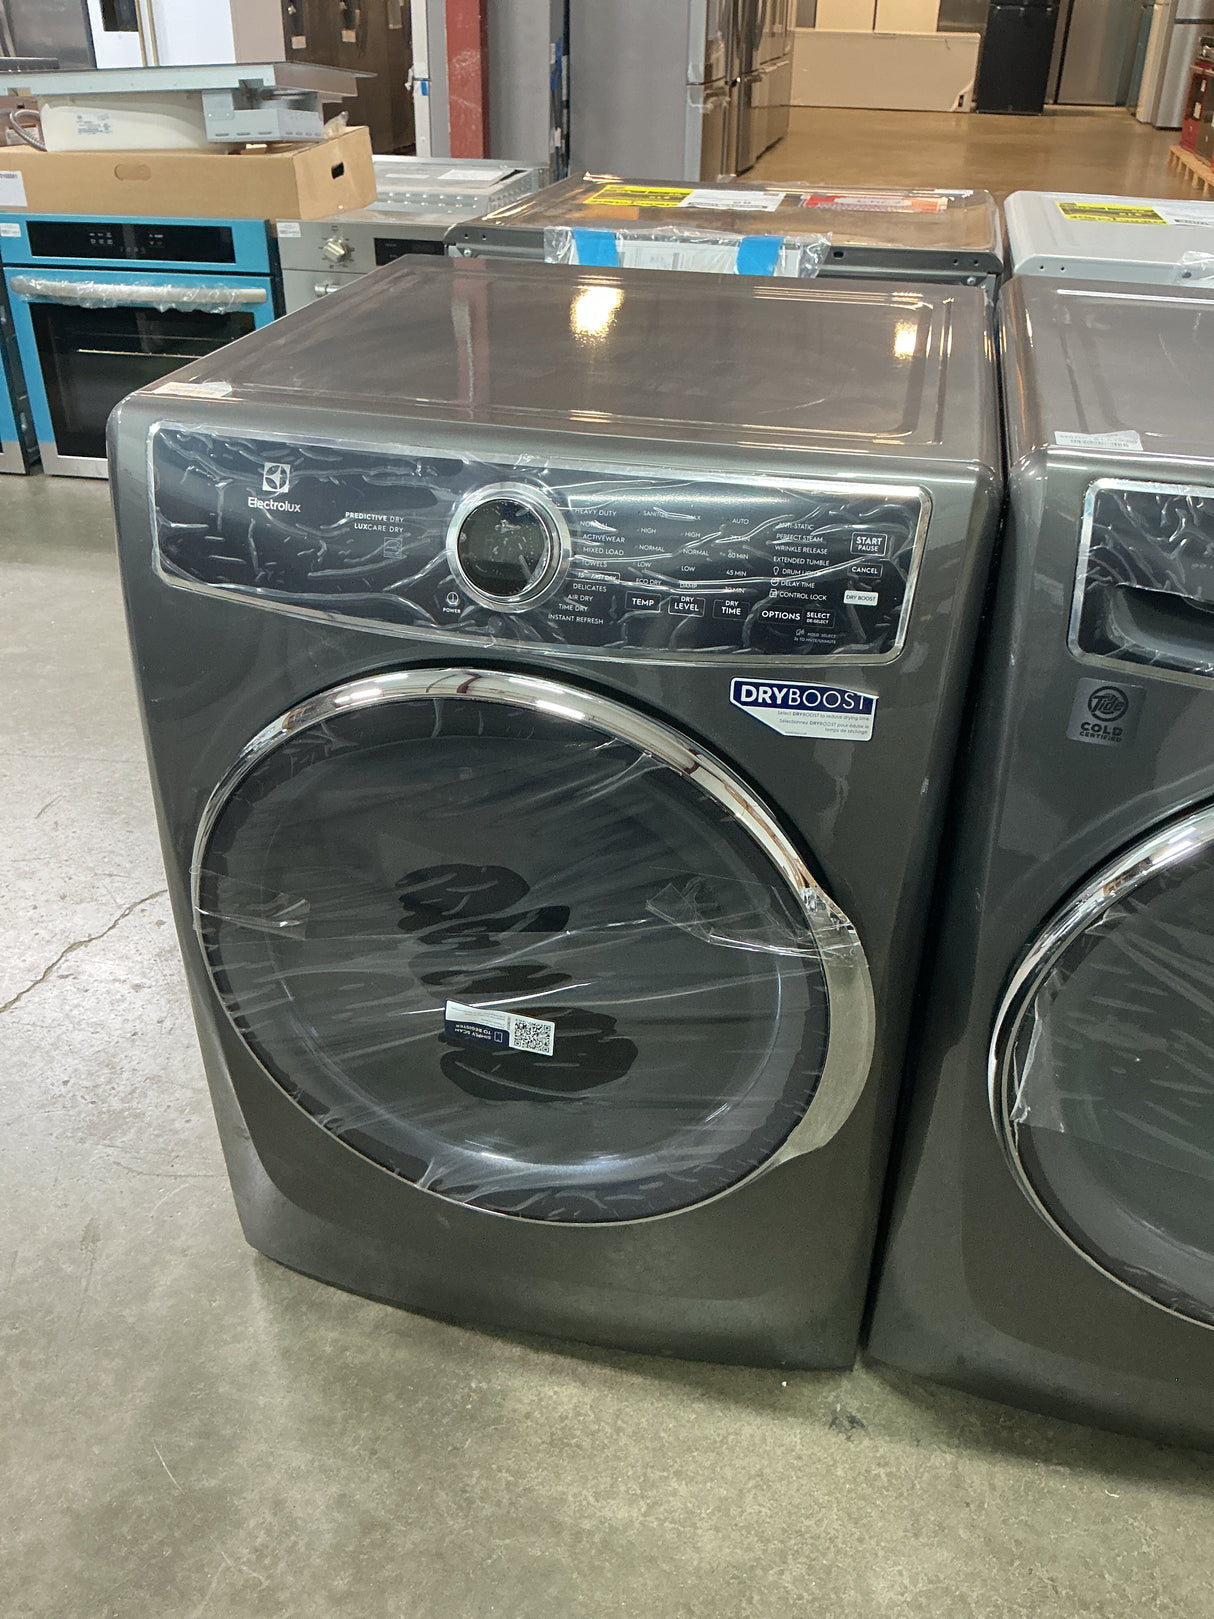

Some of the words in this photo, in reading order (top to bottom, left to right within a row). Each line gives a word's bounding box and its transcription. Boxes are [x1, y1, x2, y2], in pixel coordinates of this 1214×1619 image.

[248, 496, 301, 512] Electrolux
[345, 511, 388, 522] PREDICTIVE
[354, 523, 386, 532] LUXCARE
[776, 522, 814, 531] ANTI-STATIC
[583, 534, 625, 543] ACTIVEWEAR
[776, 533, 801, 541] PERFECT
[856, 536, 882, 545] START
[583, 546, 604, 554] MIXED
[639, 544, 665, 552] NORMAL
[683, 548, 709, 556] NORMAL
[802, 547, 828, 555] RELEASE
[774, 556, 805, 564] EXTENDED
[806, 558, 830, 566] TUMBLE
[852, 566, 878, 574] CANCEL
[573, 583, 607, 593] DELICATES
[780, 591, 809, 599] CONTROL
[810, 593, 827, 601] LOCK
[632, 598, 655, 607] TEMP
[674, 603, 699, 611] LEVEL
[721, 606, 741, 615] TIME
[576, 616, 604, 624] REFRESH
[761, 610, 801, 621] OPTIONS
[740, 685, 867, 710] DRYBOOST
[1092, 693, 1125, 713] Tide
[1081, 722, 1123, 736] COLD
[1080, 731, 1122, 742] CERTIFIED
[454, 1028, 470, 1036] SCAN
[455, 1024, 483, 1033] REGISTER
[472, 1032, 492, 1040] SIMPLY
